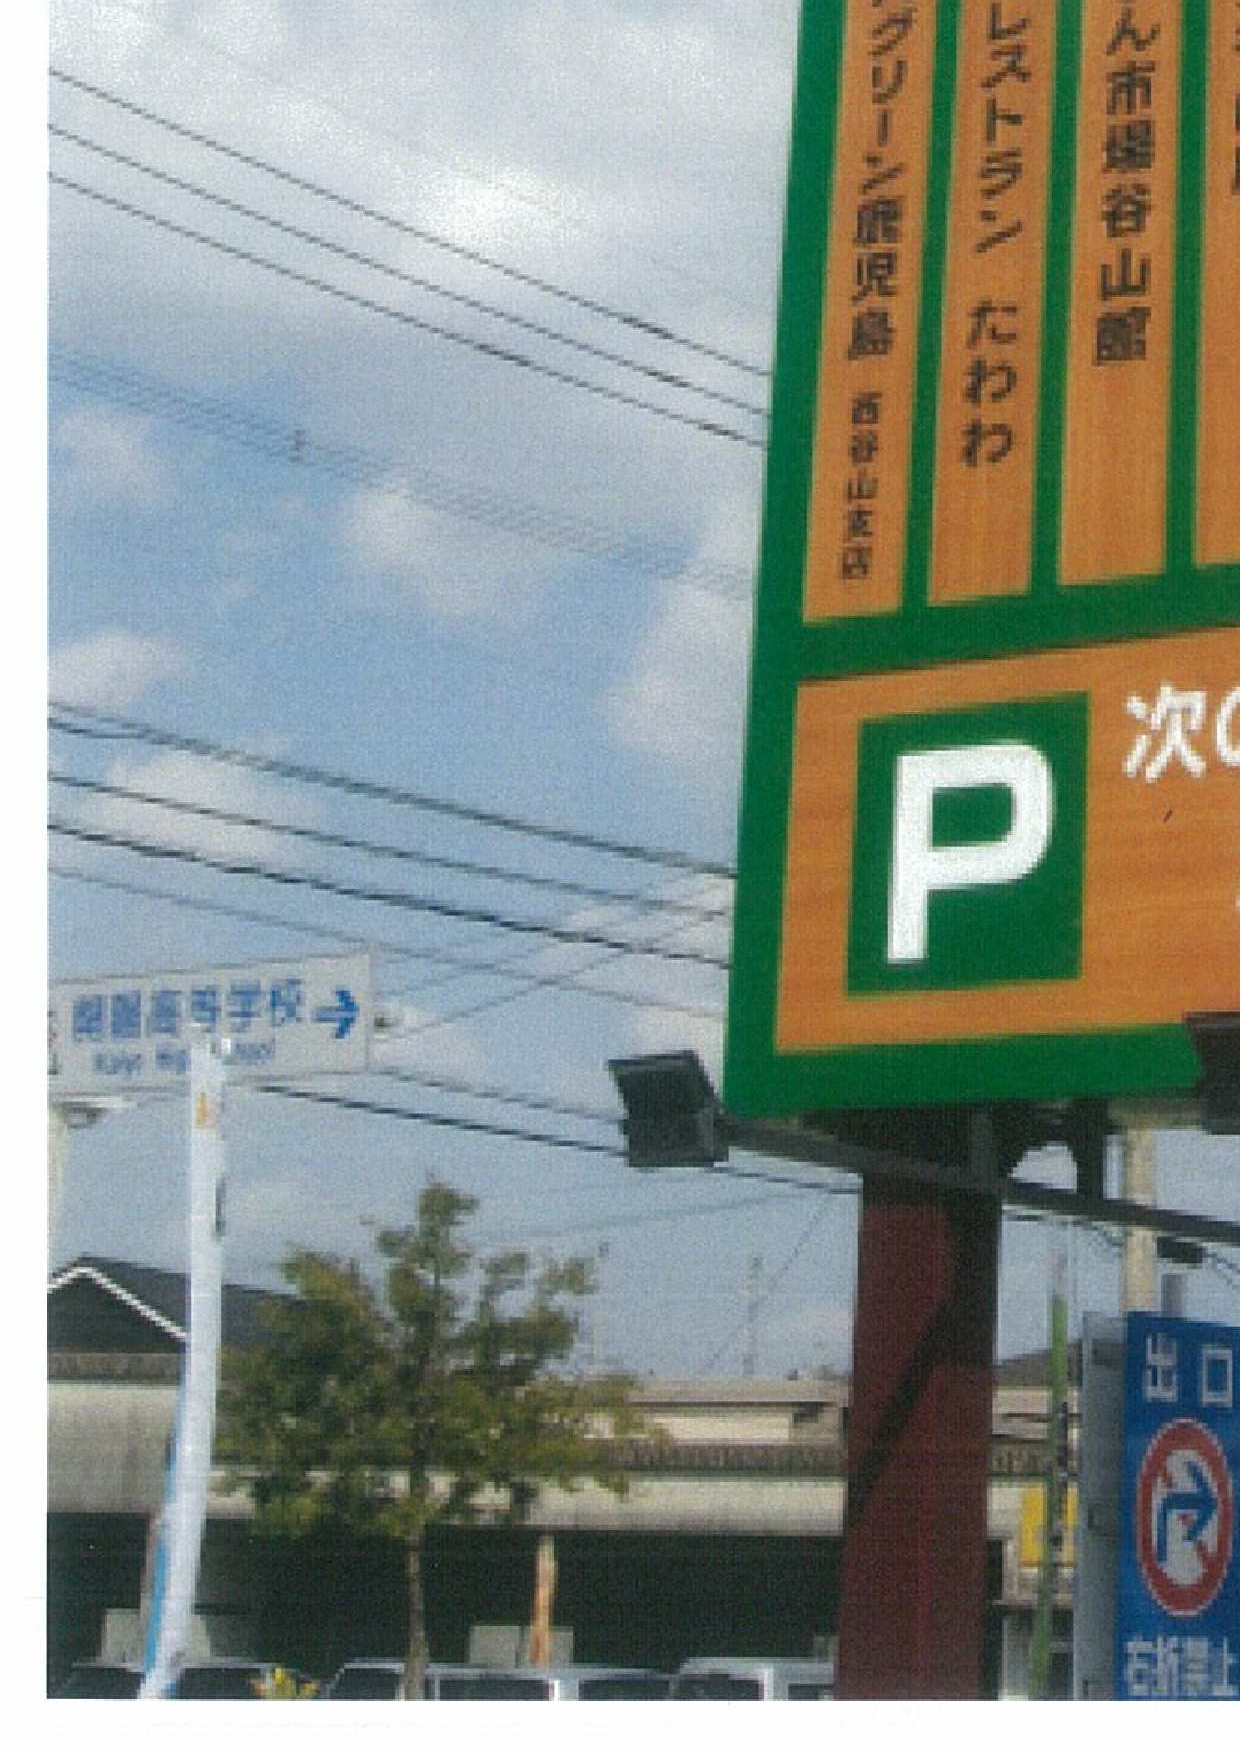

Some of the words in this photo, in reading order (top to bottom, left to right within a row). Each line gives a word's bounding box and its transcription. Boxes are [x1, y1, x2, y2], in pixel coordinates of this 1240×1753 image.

[886, 741, 1053, 964] P
[1142, 1331, 1234, 1409] 出口
[1122, 1633, 1240, 1700] 右折禁止
